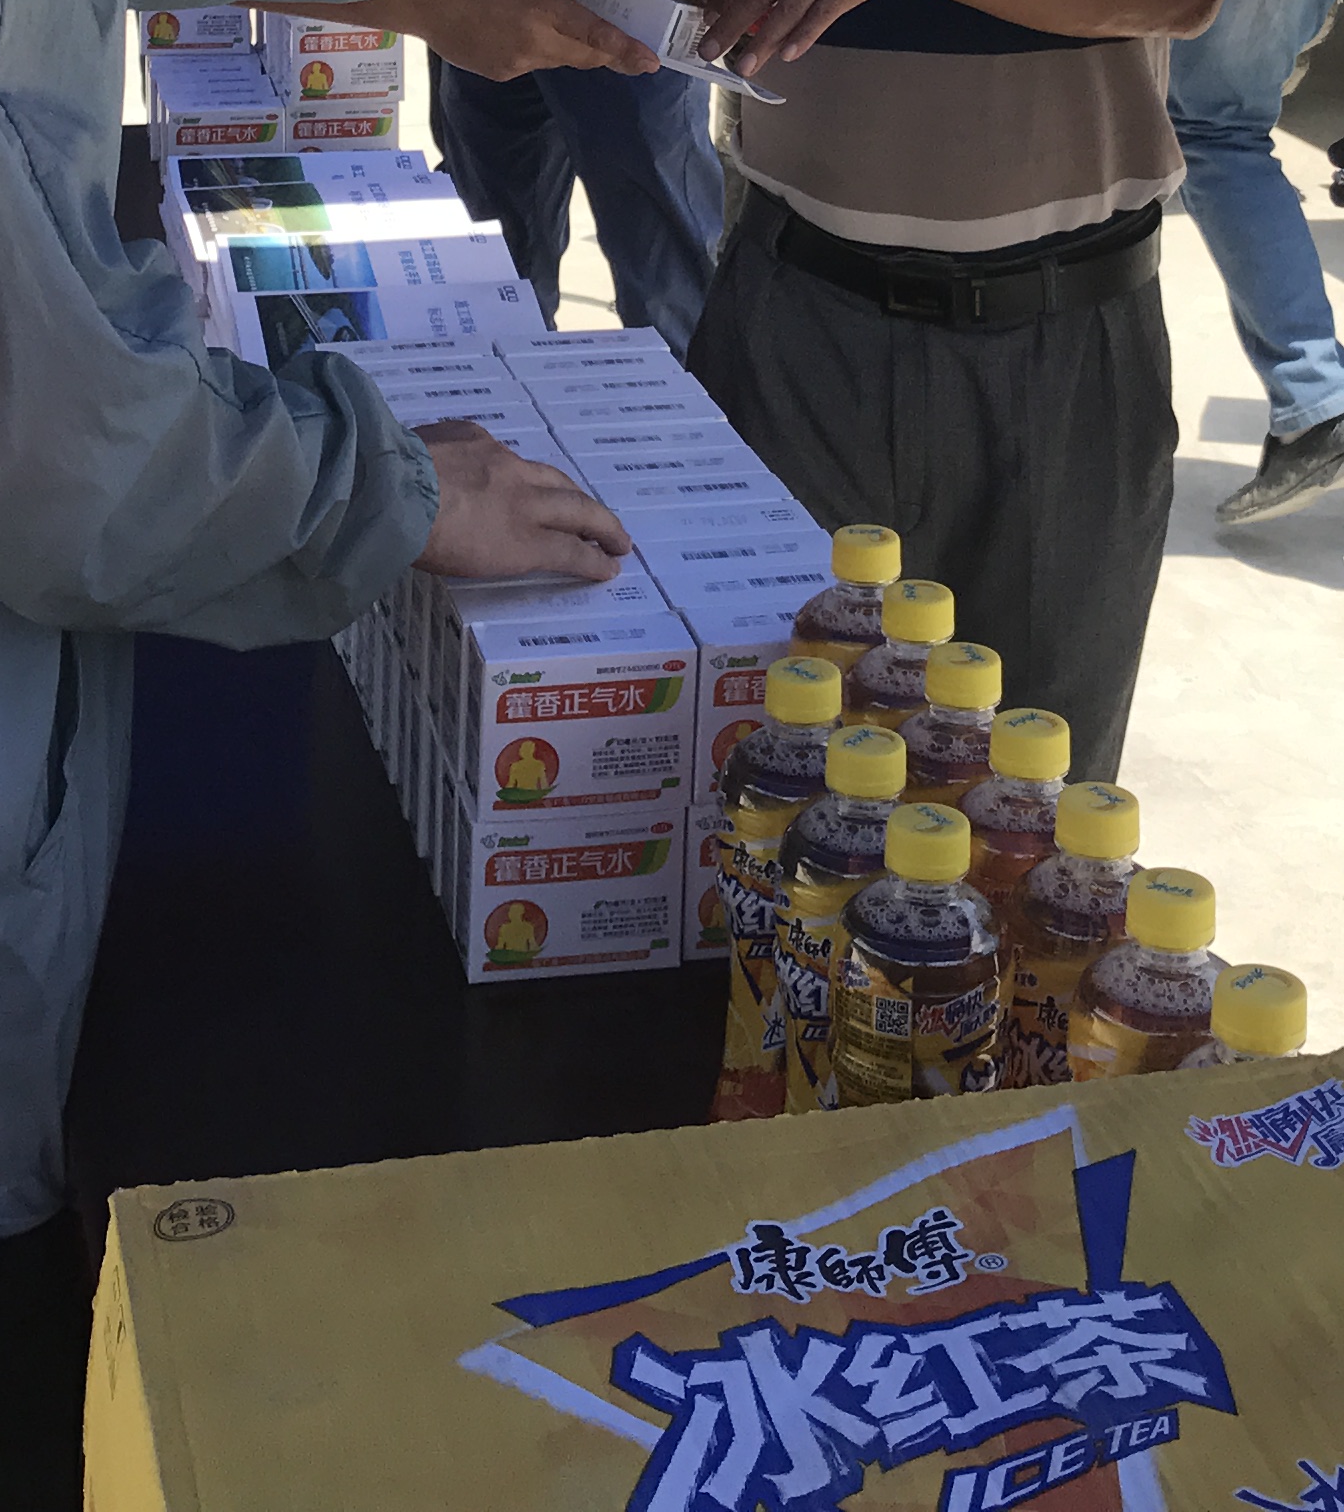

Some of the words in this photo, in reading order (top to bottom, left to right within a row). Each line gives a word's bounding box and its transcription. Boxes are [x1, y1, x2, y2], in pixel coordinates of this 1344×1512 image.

[304, 33, 379, 52] 藿香正气水
[180, 126, 258, 144] 藿香正气水
[297, 120, 373, 138] 藿香正气水
[506, 685, 645, 719] 藿香正气水
[494, 849, 633, 882] 藿香正气水
[630, 1289, 1211, 1512] 冰红茶
[950, 1436, 1090, 1512] ICE
[1109, 1417, 1171, 1455] TEA
